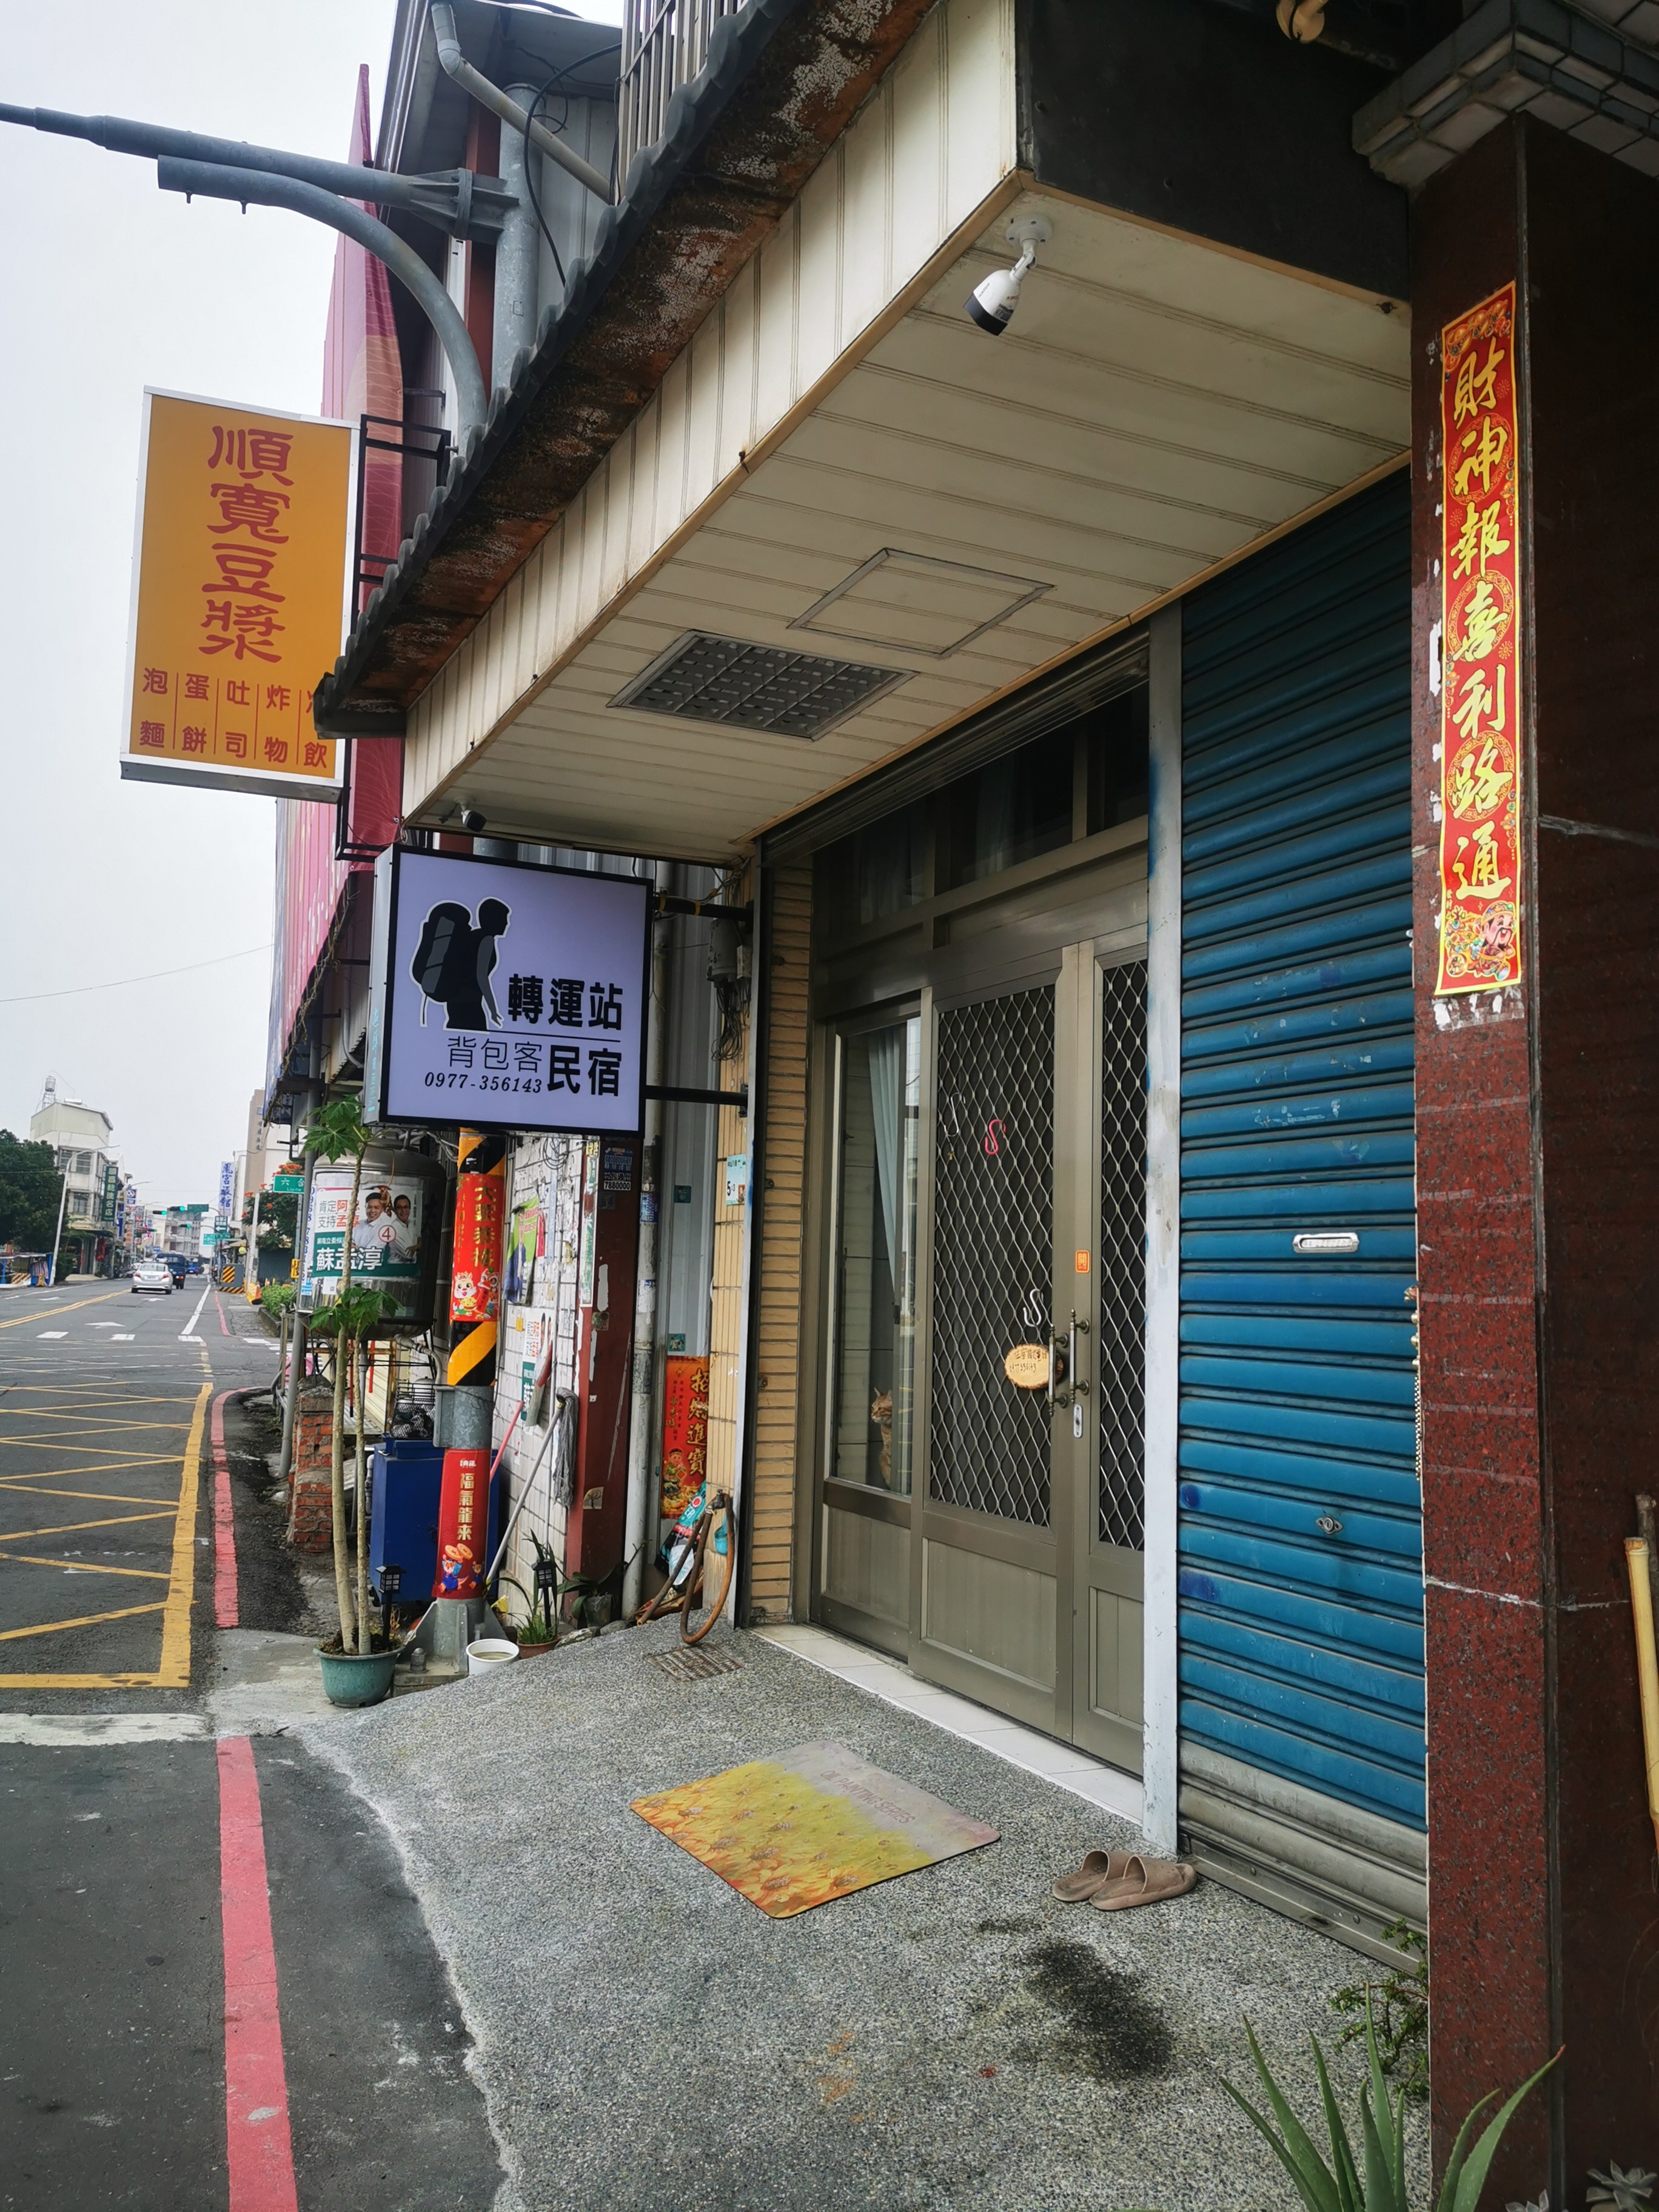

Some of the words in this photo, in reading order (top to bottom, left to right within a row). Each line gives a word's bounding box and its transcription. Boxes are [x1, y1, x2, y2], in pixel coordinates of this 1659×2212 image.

[199, 426, 294, 663] 順寬豆漿
[139, 668, 168, 749] 泡麵
[182, 673, 209, 754] 蛋餅
[226, 680, 250, 759] 吐司
[264, 684, 290, 763] 炸物
[508, 973, 623, 1031] 轉運站
[424, 1071, 543, 1094] 0977-356143
[447, 1036, 543, 1074] 背包客
[547, 1044, 622, 1097] 民宿
[605, 1181, 630, 1190] 7880000
[381, 1227, 391, 1239] 4
[686, 1368, 709, 1475] 招財進寶
[457, 1472, 475, 1541] 福氣龍來
[820, 1770, 841, 1781] OIL
[833, 1777, 882, 1805] PAINTING
[874, 1798, 916, 1823] SERIES
